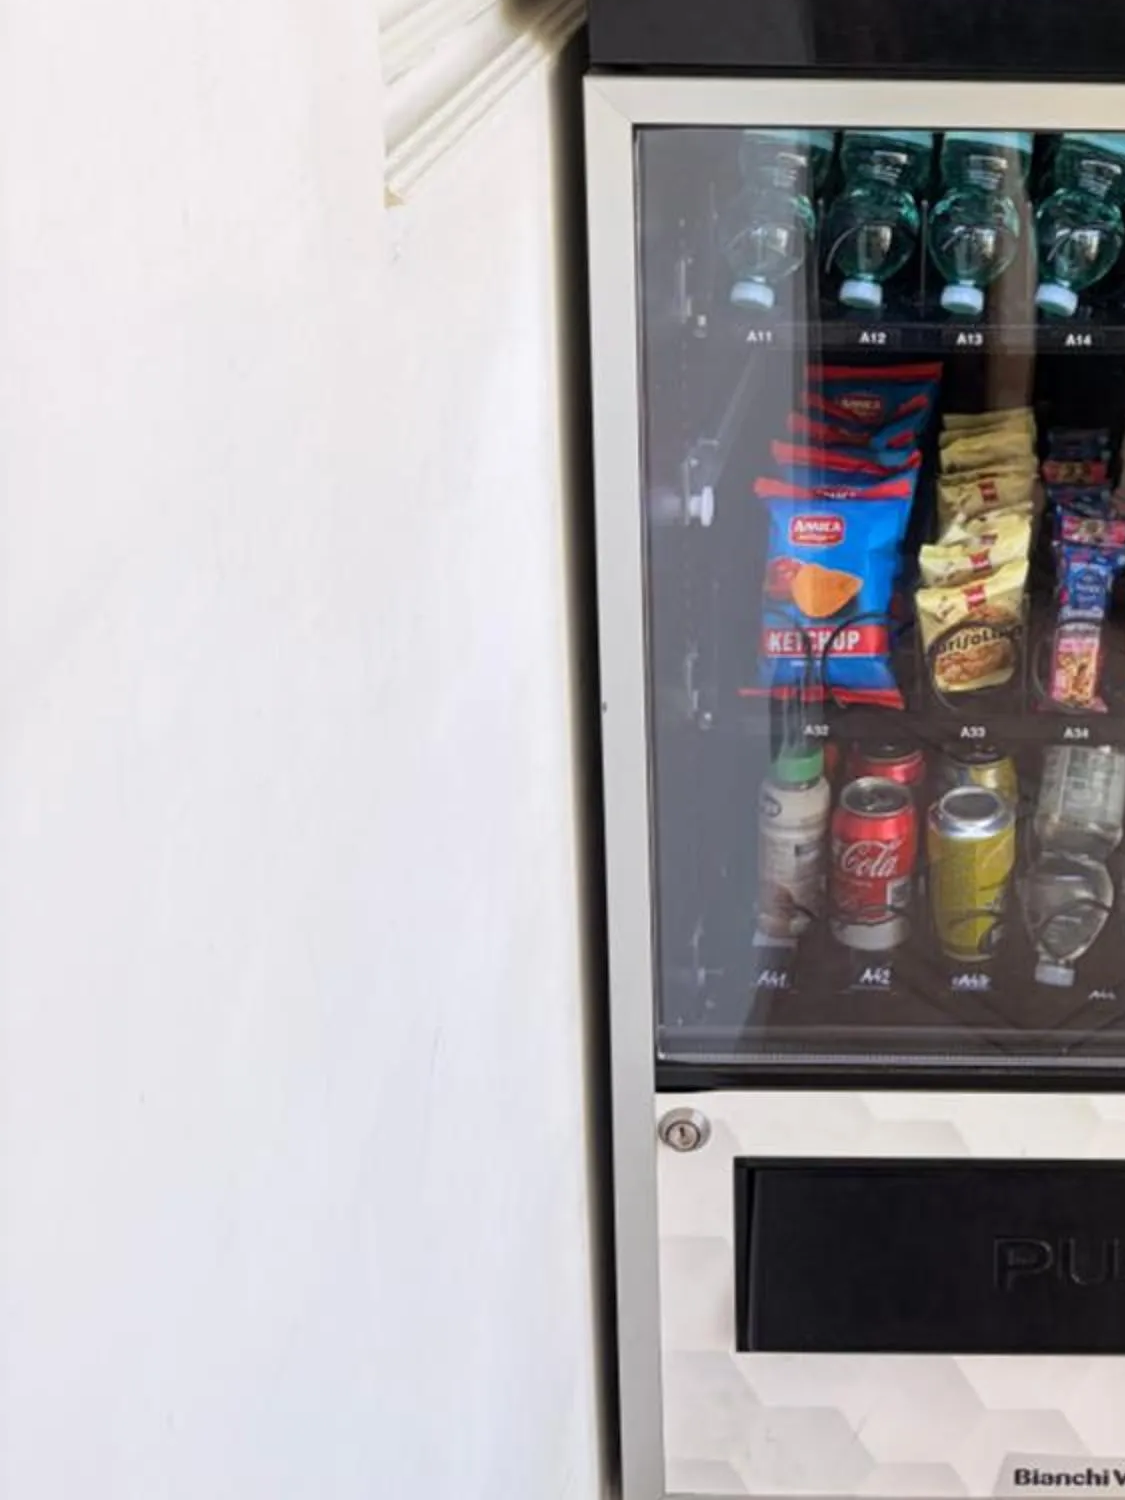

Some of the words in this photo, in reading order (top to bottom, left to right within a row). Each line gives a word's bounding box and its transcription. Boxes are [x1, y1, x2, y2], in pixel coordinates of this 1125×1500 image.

[746, 331, 774, 343] A11
[859, 332, 887, 345] A12
[956, 332, 984, 346] A13
[1065, 334, 1092, 347] A14
[768, 629, 861, 653] KETCHUP
[804, 726, 829, 736] A32
[961, 727, 985, 738] A33
[1064, 728, 1089, 739] A34
[841, 838, 904, 878] Cola
[860, 970, 891, 985] A42
[1014, 1468, 1110, 1488] Bianchi
